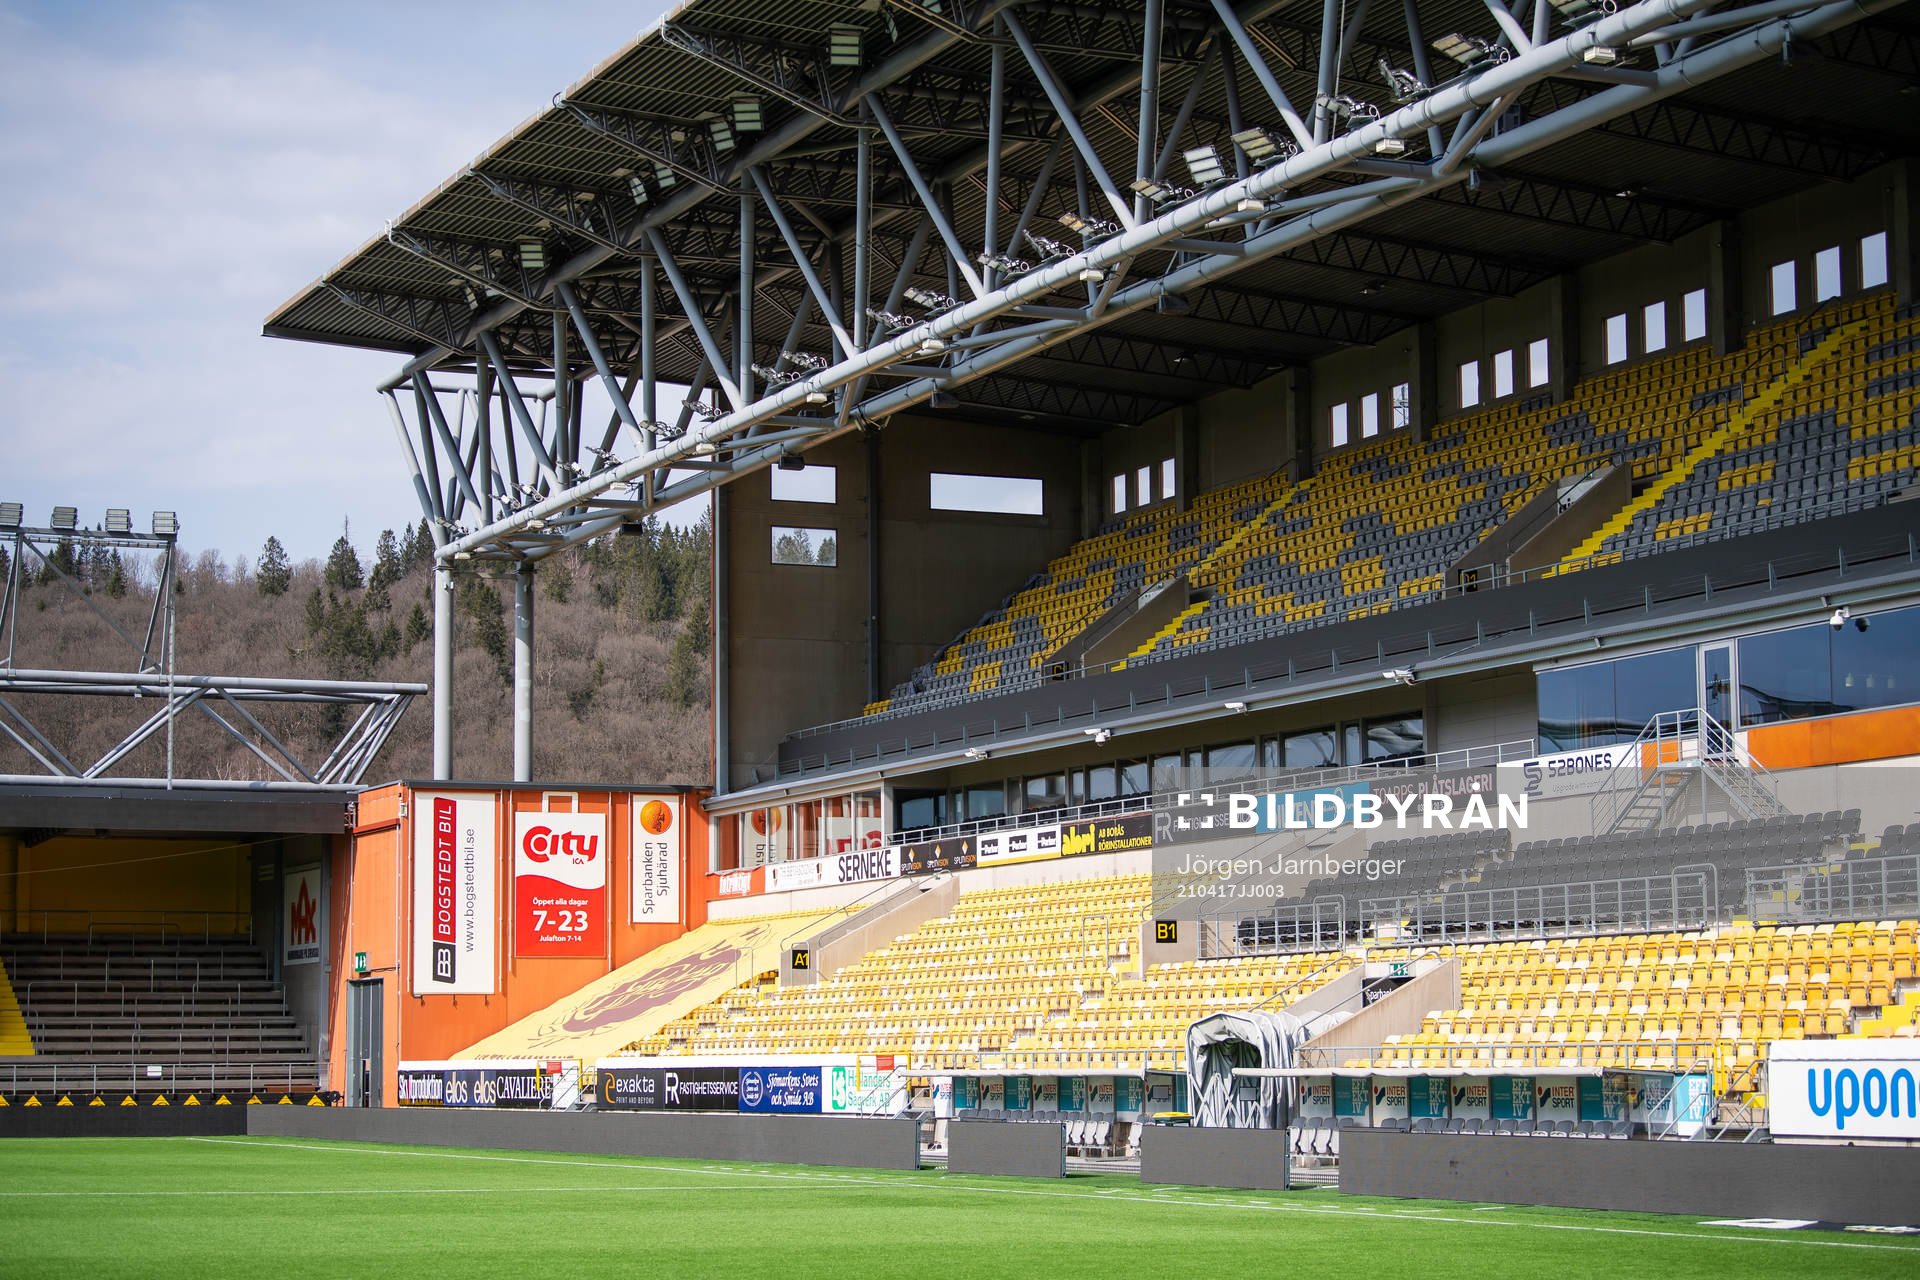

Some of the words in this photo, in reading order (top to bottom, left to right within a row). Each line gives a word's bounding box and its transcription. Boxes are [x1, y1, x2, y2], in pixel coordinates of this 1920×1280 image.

[1548, 753, 1612, 778] 52BONES
[439, 805, 452, 833] BIL
[523, 826, 598, 863] City
[656, 842, 670, 896] Sjuhärad
[838, 849, 892, 883] SERNEKE
[643, 842, 655, 914] Sparbanken
[439, 838, 452, 935] BOGSTEDT
[464, 828, 477, 953] www.bogstedtbil.se
[532, 896, 554, 906] Öppet
[569, 898, 588, 906] dagar
[291, 877, 317, 945] MAX
[532, 910, 589, 932] 7-23
[1157, 923, 1176, 940] B1
[794, 952, 809, 966] A1
[446, 1072, 468, 1103] elos
[473, 1071, 497, 1104] elos
[616, 1074, 655, 1093] exakta
[801, 1072, 819, 1088] Svets
[679, 1081, 738, 1096] FASTIGHETSSERVICE
[1099, 1084, 1113, 1093] INTER
[1312, 1085, 1331, 1095] INTER
[1386, 1086, 1405, 1095] INTER
[1466, 1085, 1488, 1096] INTER
[1552, 1086, 1575, 1097] INTER
[771, 1090, 783, 1105] och
[1099, 1093, 1113, 1102] SPORT
[1312, 1095, 1331, 1105] SPORT
[1386, 1096, 1405, 1106] SPORT
[1466, 1097, 1487, 1107] SPORT
[1552, 1098, 1574, 1108] SPORT
[1808, 1068, 1920, 1130] upon
